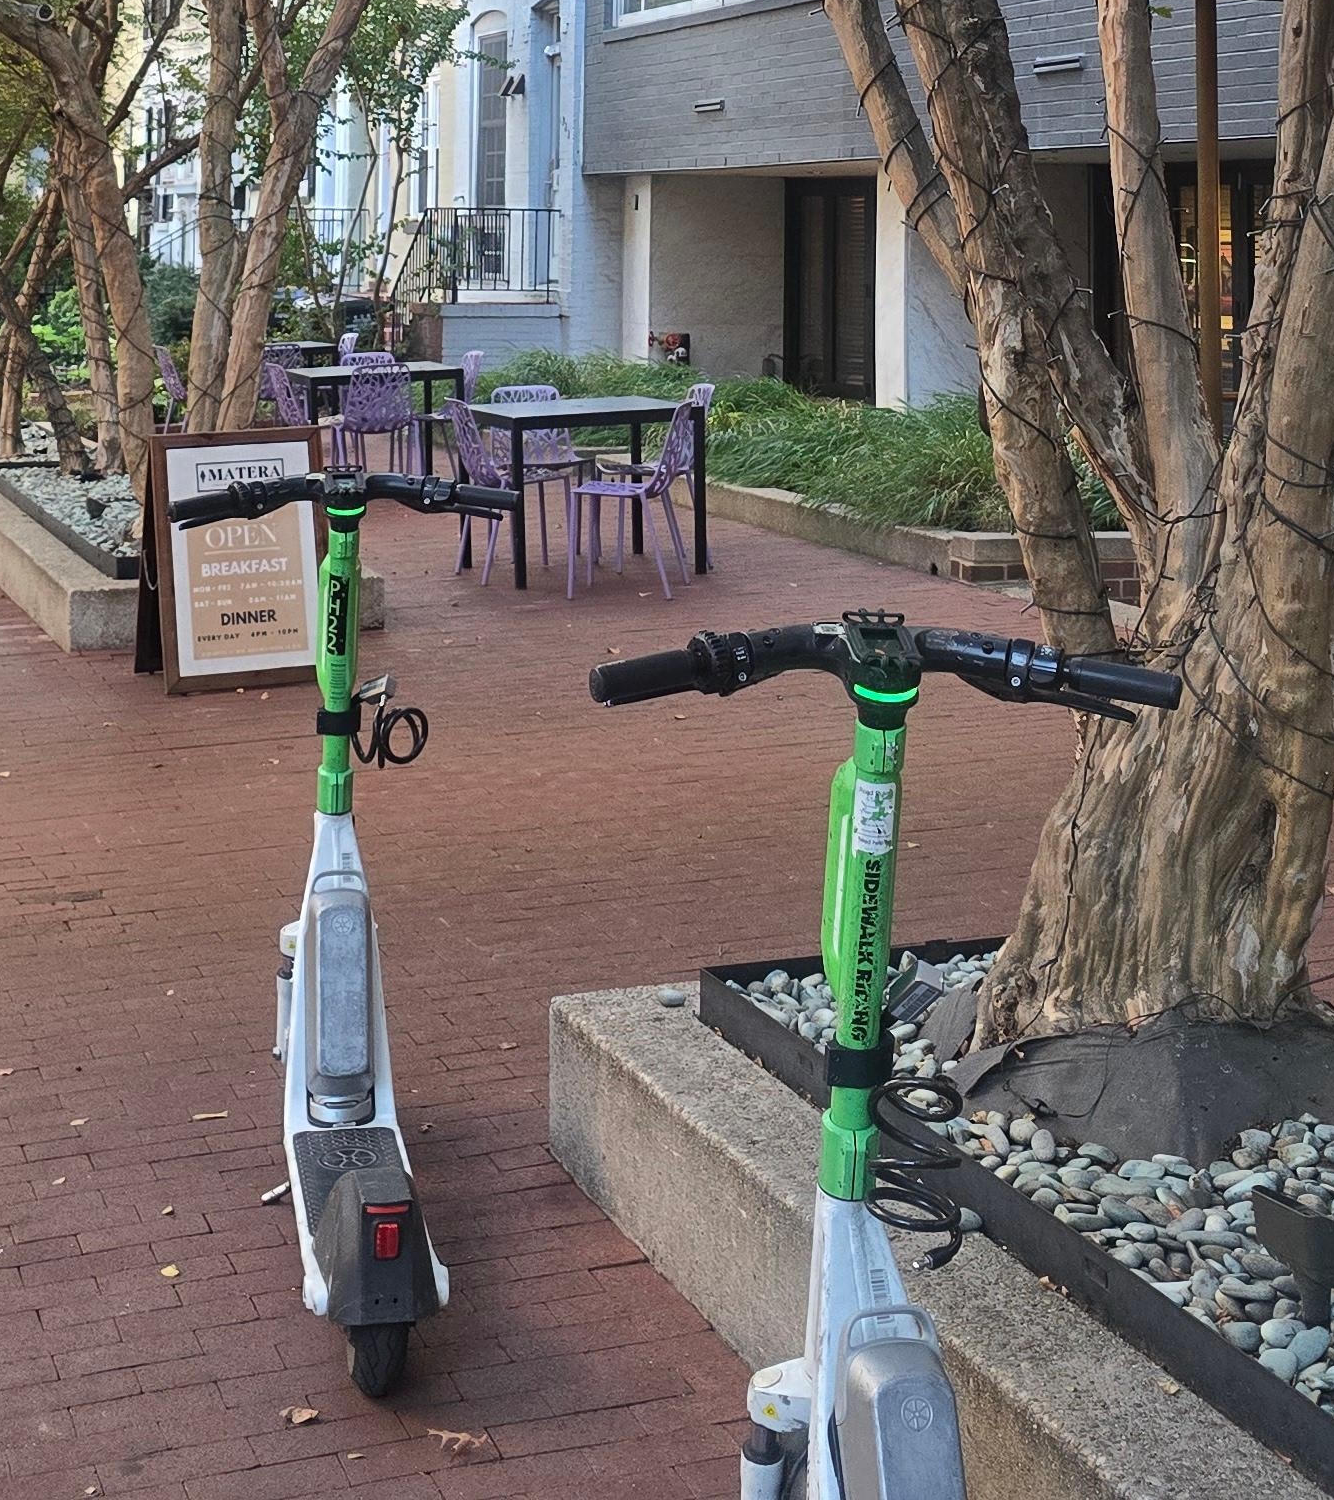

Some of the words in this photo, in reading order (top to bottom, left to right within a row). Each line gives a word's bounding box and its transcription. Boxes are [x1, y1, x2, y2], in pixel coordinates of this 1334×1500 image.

[208, 464, 281, 482] MATERA
[205, 523, 280, 550] OPEN
[201, 557, 288, 577] BREAKFAST
[220, 609, 278, 627] DINNER
[197, 634, 222, 642] EVERY
[857, 859, 881, 965] SIDEWALK
